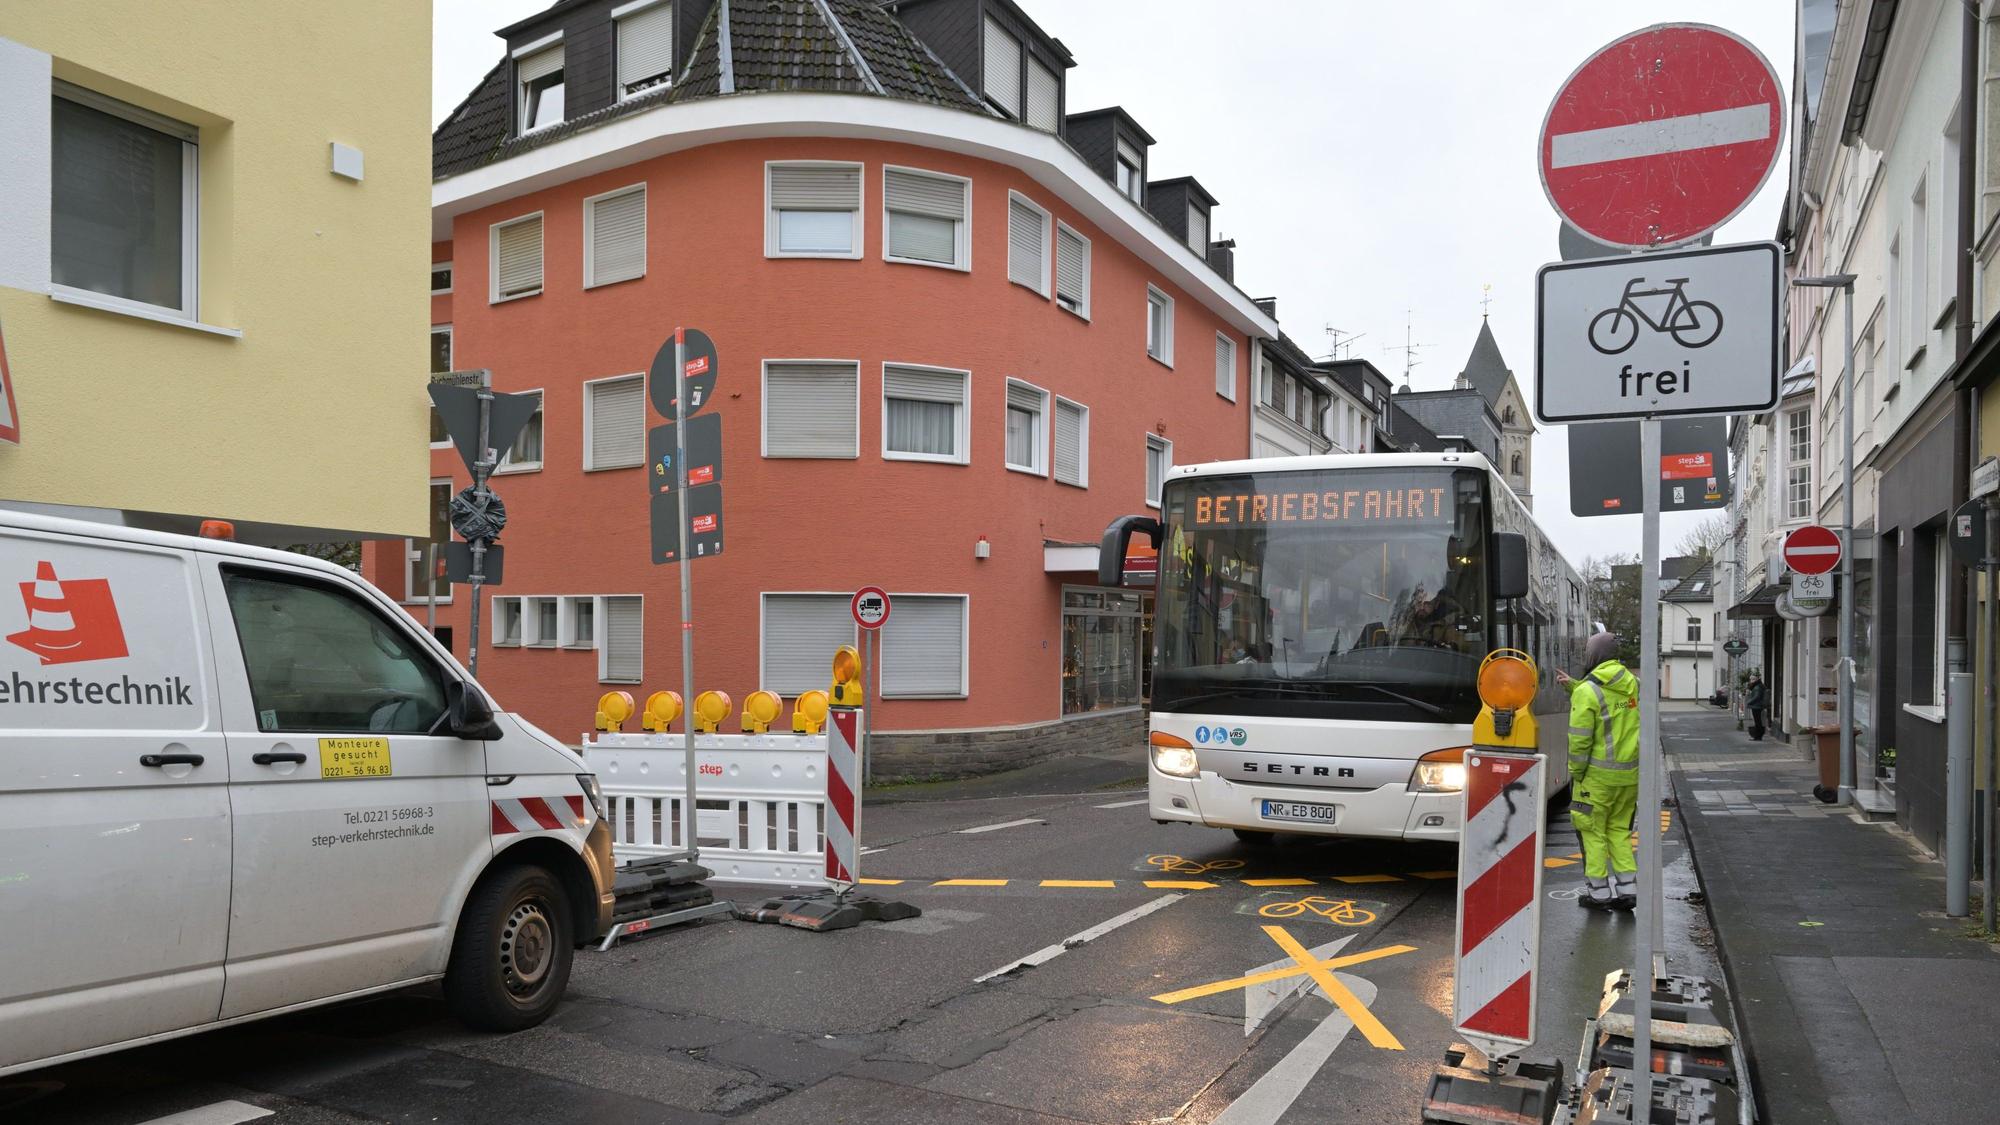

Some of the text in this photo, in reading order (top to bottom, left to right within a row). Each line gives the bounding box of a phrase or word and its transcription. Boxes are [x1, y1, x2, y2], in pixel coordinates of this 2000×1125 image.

[1619, 360, 1690, 397] frei
[1678, 457, 1694, 465] step
[1196, 488, 1445, 523] BETRIEBSFAHRT
[328, 740, 380, 748] Monteure
[334, 751, 378, 761] gesucht
[324, 767, 344, 776] 0221
[353, 766, 364, 775] 56
[366, 766, 376, 774] 96
[379, 765, 389, 774] 83
[699, 763, 722, 776] step
[1243, 762, 1355, 777] SETRA
[392, 806, 434, 820] 56968-3
[1269, 803, 1333, 819] NR EB 800
[311, 823, 434, 848] step-verkehrstechnik.de
